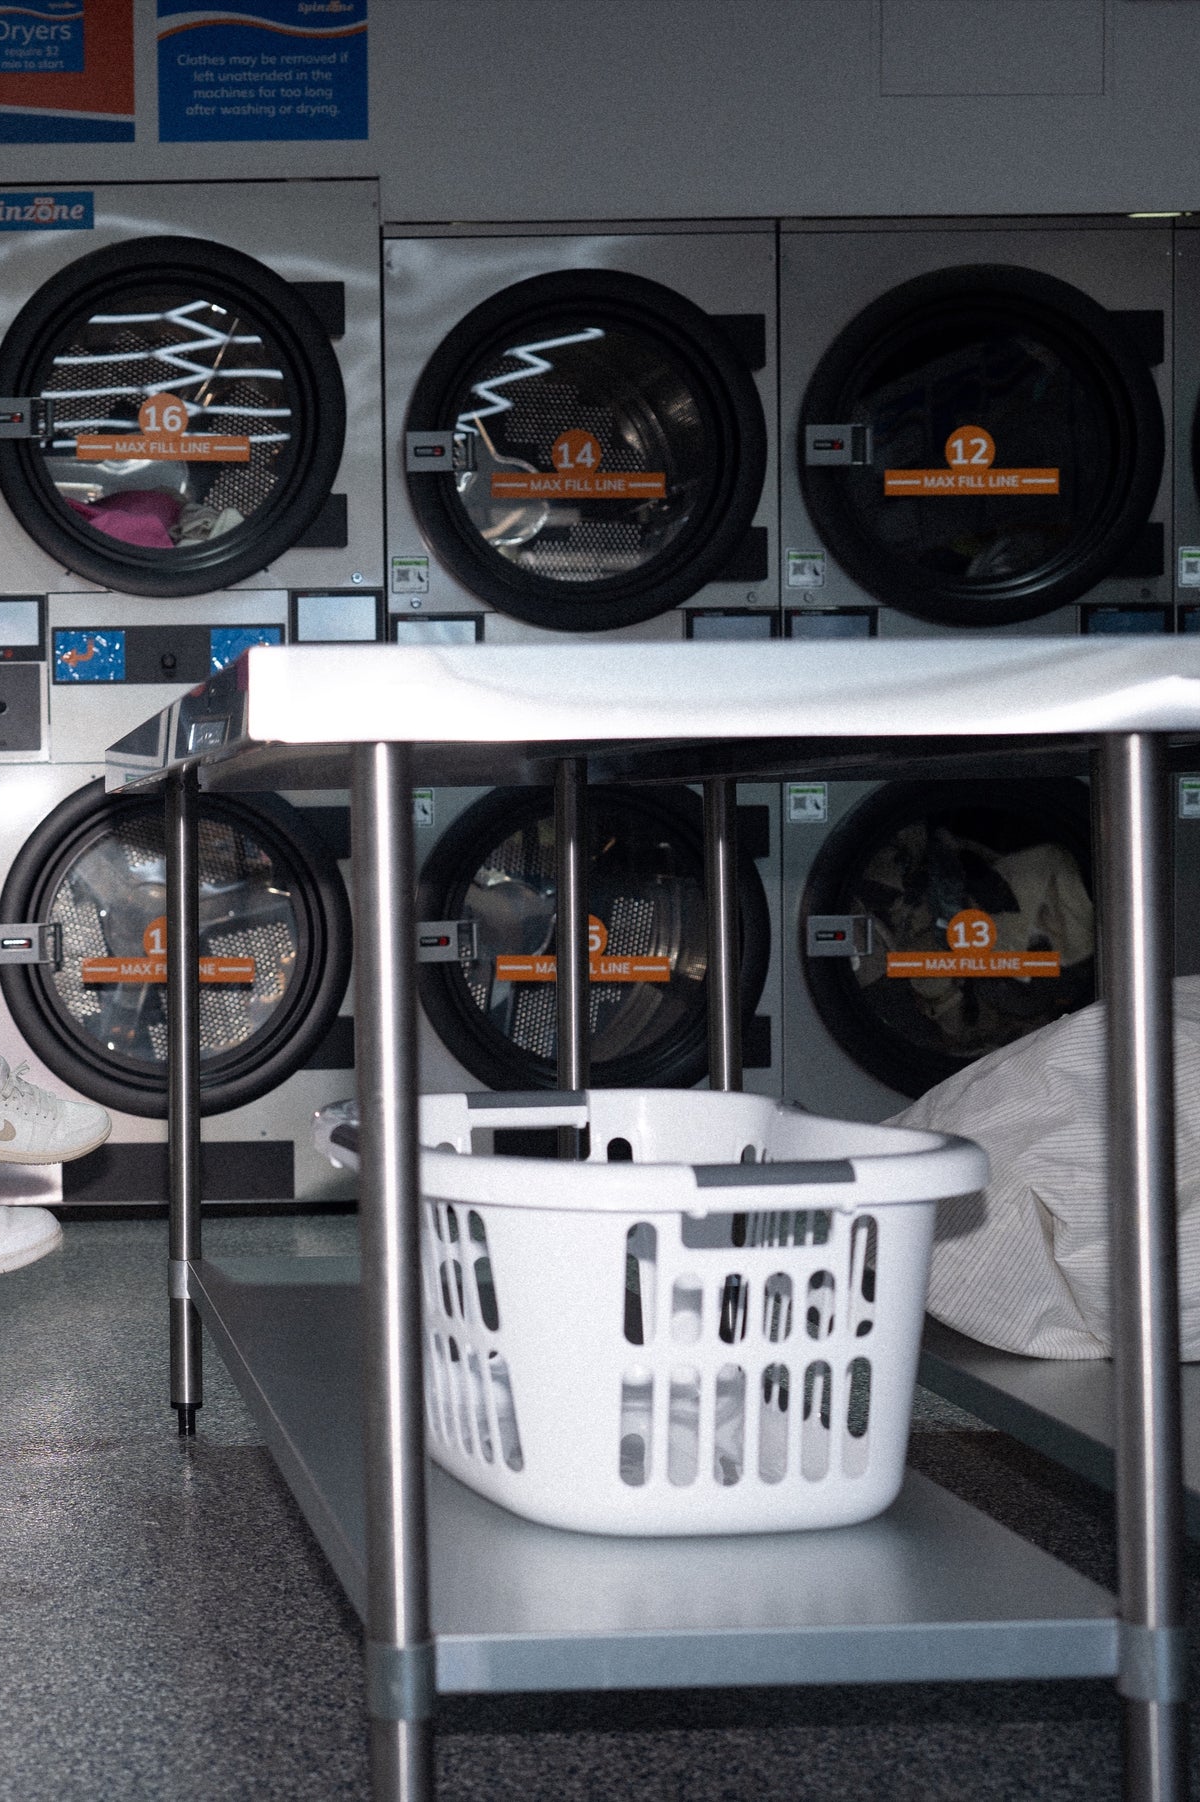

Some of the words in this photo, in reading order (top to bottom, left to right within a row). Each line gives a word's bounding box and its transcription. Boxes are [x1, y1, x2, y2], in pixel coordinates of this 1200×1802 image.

[177, 53, 225, 66] Clothes
[229, 55, 257, 68] may
[260, 52, 277, 65] be
[280, 52, 337, 65] removed
[340, 51, 349, 64] if
[193, 70, 215, 82] left
[218, 70, 293, 81] unattended
[296, 70, 308, 81] in
[311, 70, 333, 81] the
[193, 87, 256, 99] machines
[258, 86, 277, 98] for
[279, 87, 302, 98] too
[304, 86, 333, 100] long
[185, 103, 216, 116] after
[220, 103, 276, 117] washing
[279, 104, 293, 115] or
[144, 405, 183, 432] 16
[115, 442, 146, 453] MAX
[150, 442, 176, 453] FILL
[180, 442, 210, 454] LINE
[558, 442, 595, 468] 14
[950, 437, 989, 465] 12
[529, 479, 560, 491] MAX
[564, 479, 593, 491] FILL
[595, 479, 625, 491] LINE
[923, 475, 955, 488] MAX
[958, 475, 985, 487] FILL
[988, 474, 1019, 487] LINE
[952, 920, 990, 948] 13
[120, 963, 152, 975] MAX
[535, 962, 557, 975] MA
[600, 962, 630, 975] LINE
[925, 958, 957, 970] MAX
[960, 957, 987, 970] FILL
[990, 957, 1021, 970] LINE
